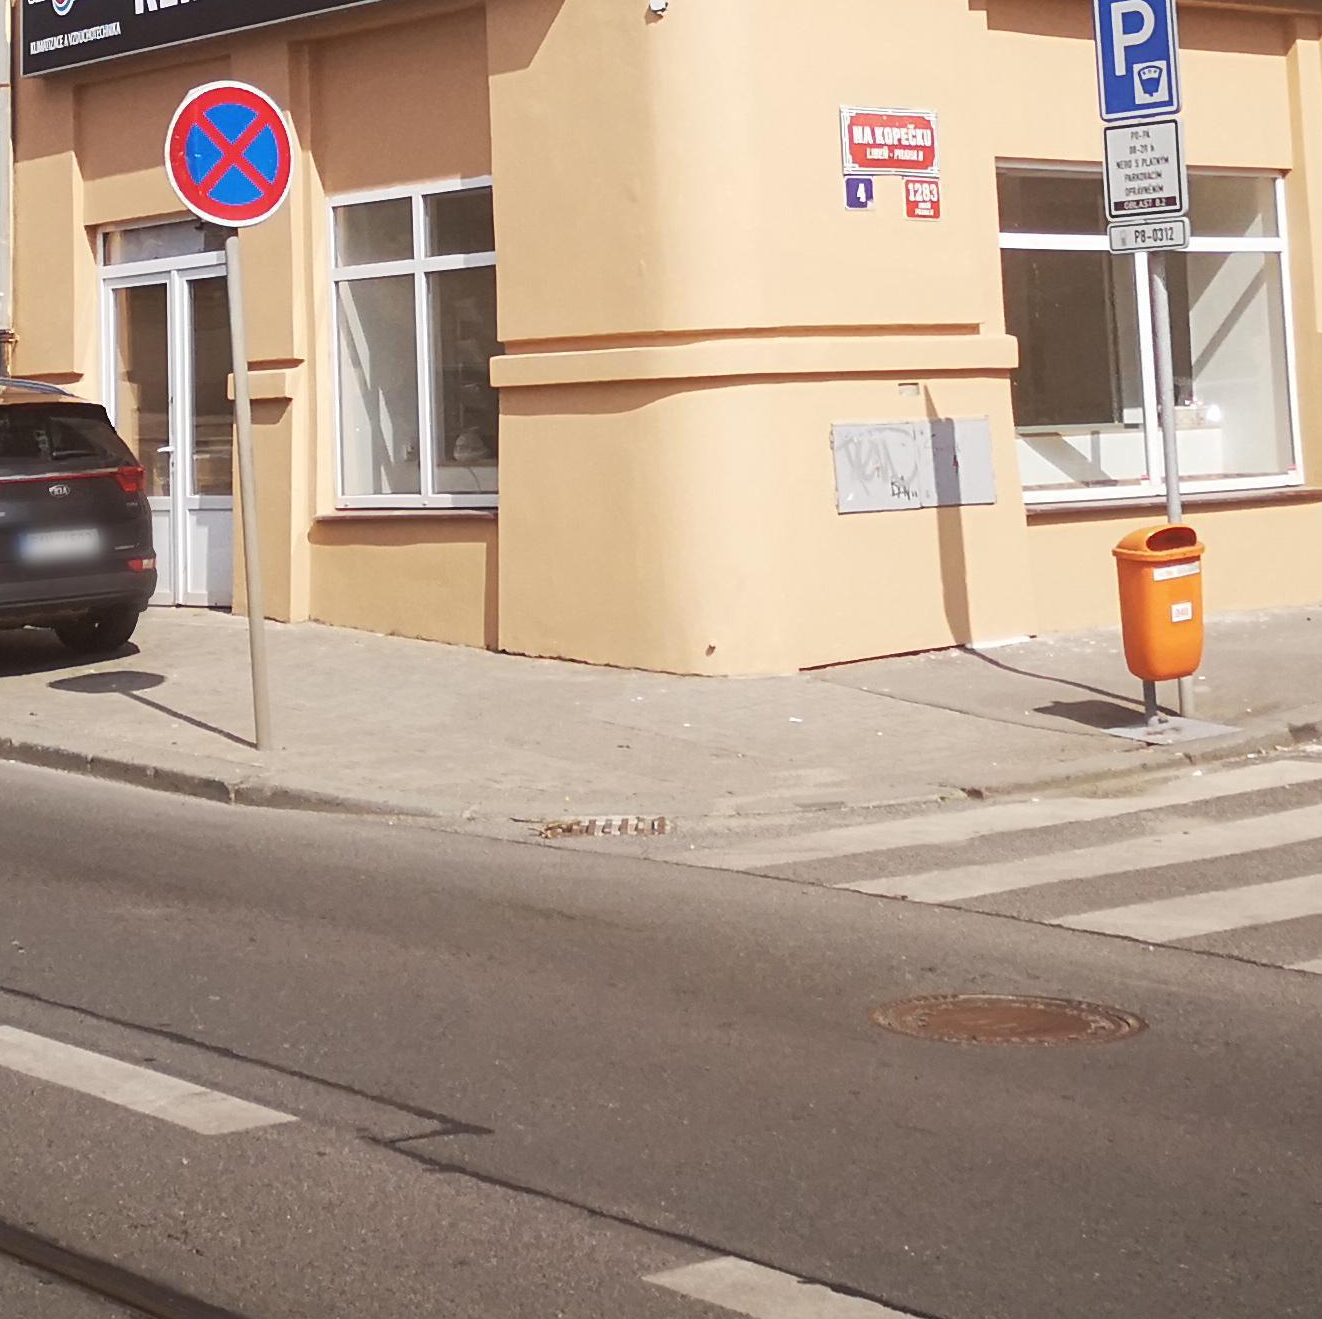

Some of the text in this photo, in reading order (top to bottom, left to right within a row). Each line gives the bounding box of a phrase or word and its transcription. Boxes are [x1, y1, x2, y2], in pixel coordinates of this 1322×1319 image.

[852, 123, 932, 147] NA KOPEČKU
[856, 183, 867, 203] 4
[908, 182, 938, 202] 1283
[1134, 226, 1175, 244] P8-0312
